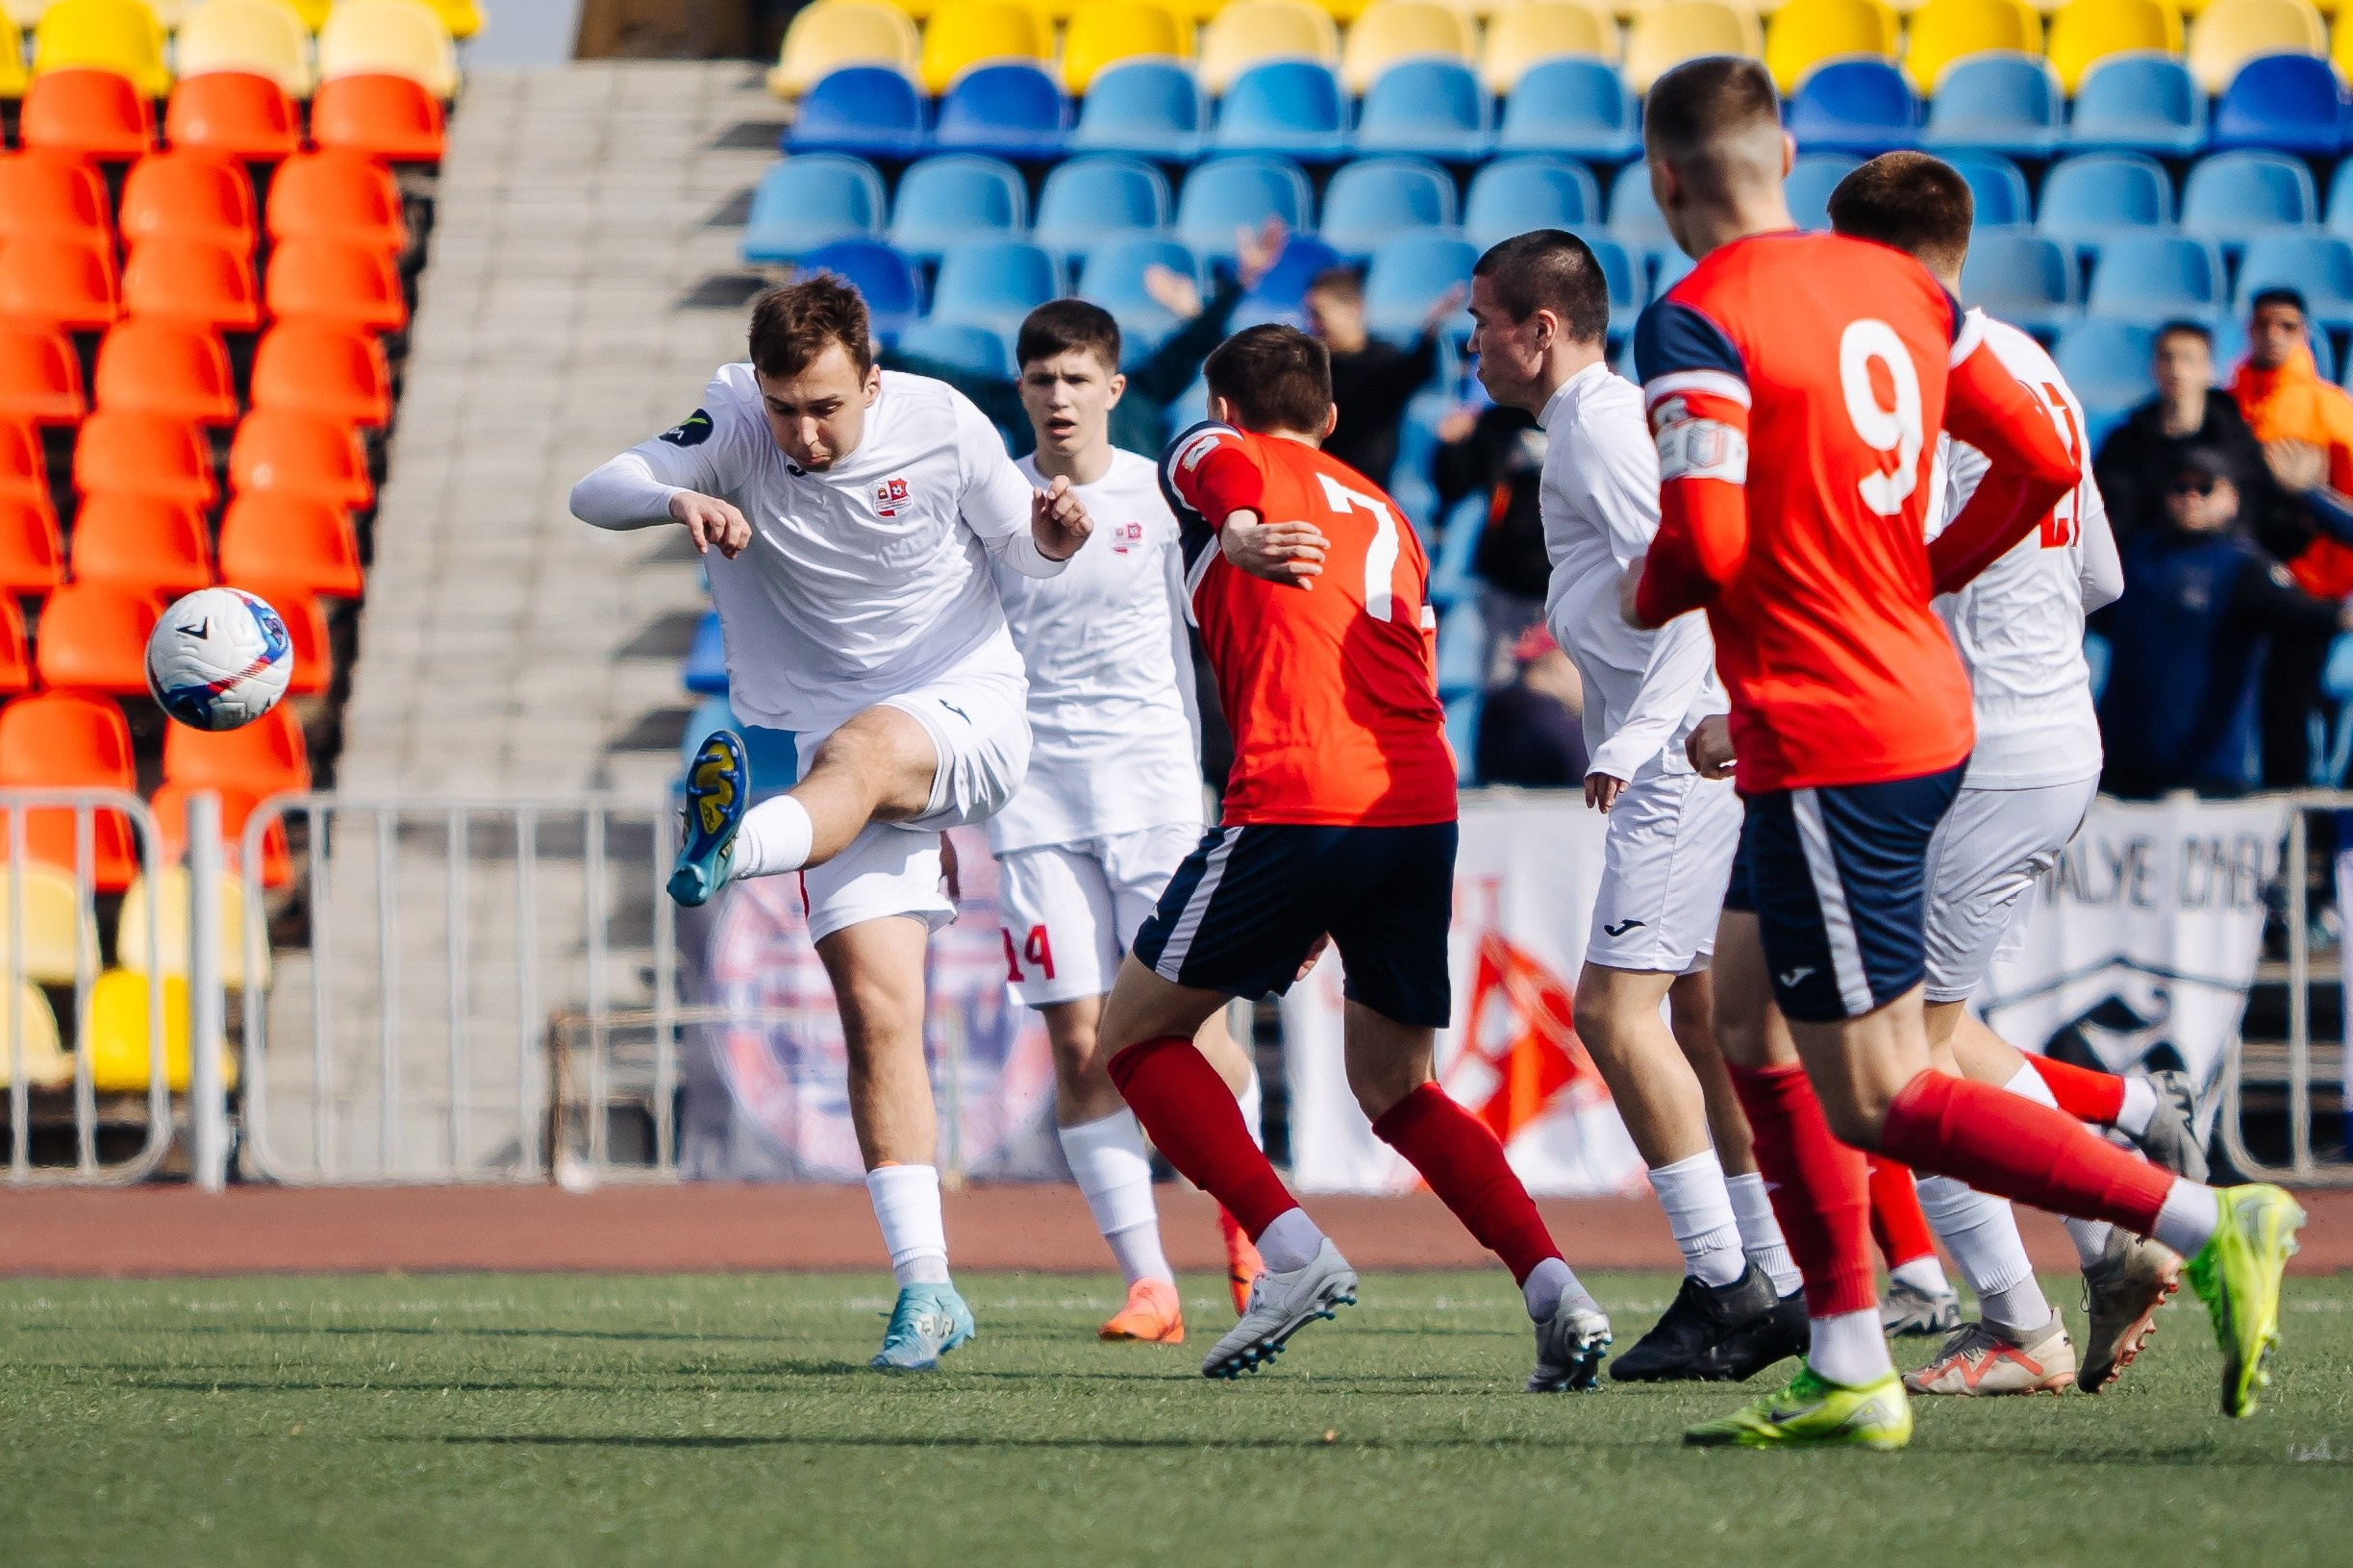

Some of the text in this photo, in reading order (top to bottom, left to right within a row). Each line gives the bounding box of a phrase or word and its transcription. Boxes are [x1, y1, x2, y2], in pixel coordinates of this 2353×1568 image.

[1839, 317, 1924, 515] 9
[1314, 471, 1400, 623] 7
[1000, 924, 1055, 983] 14
